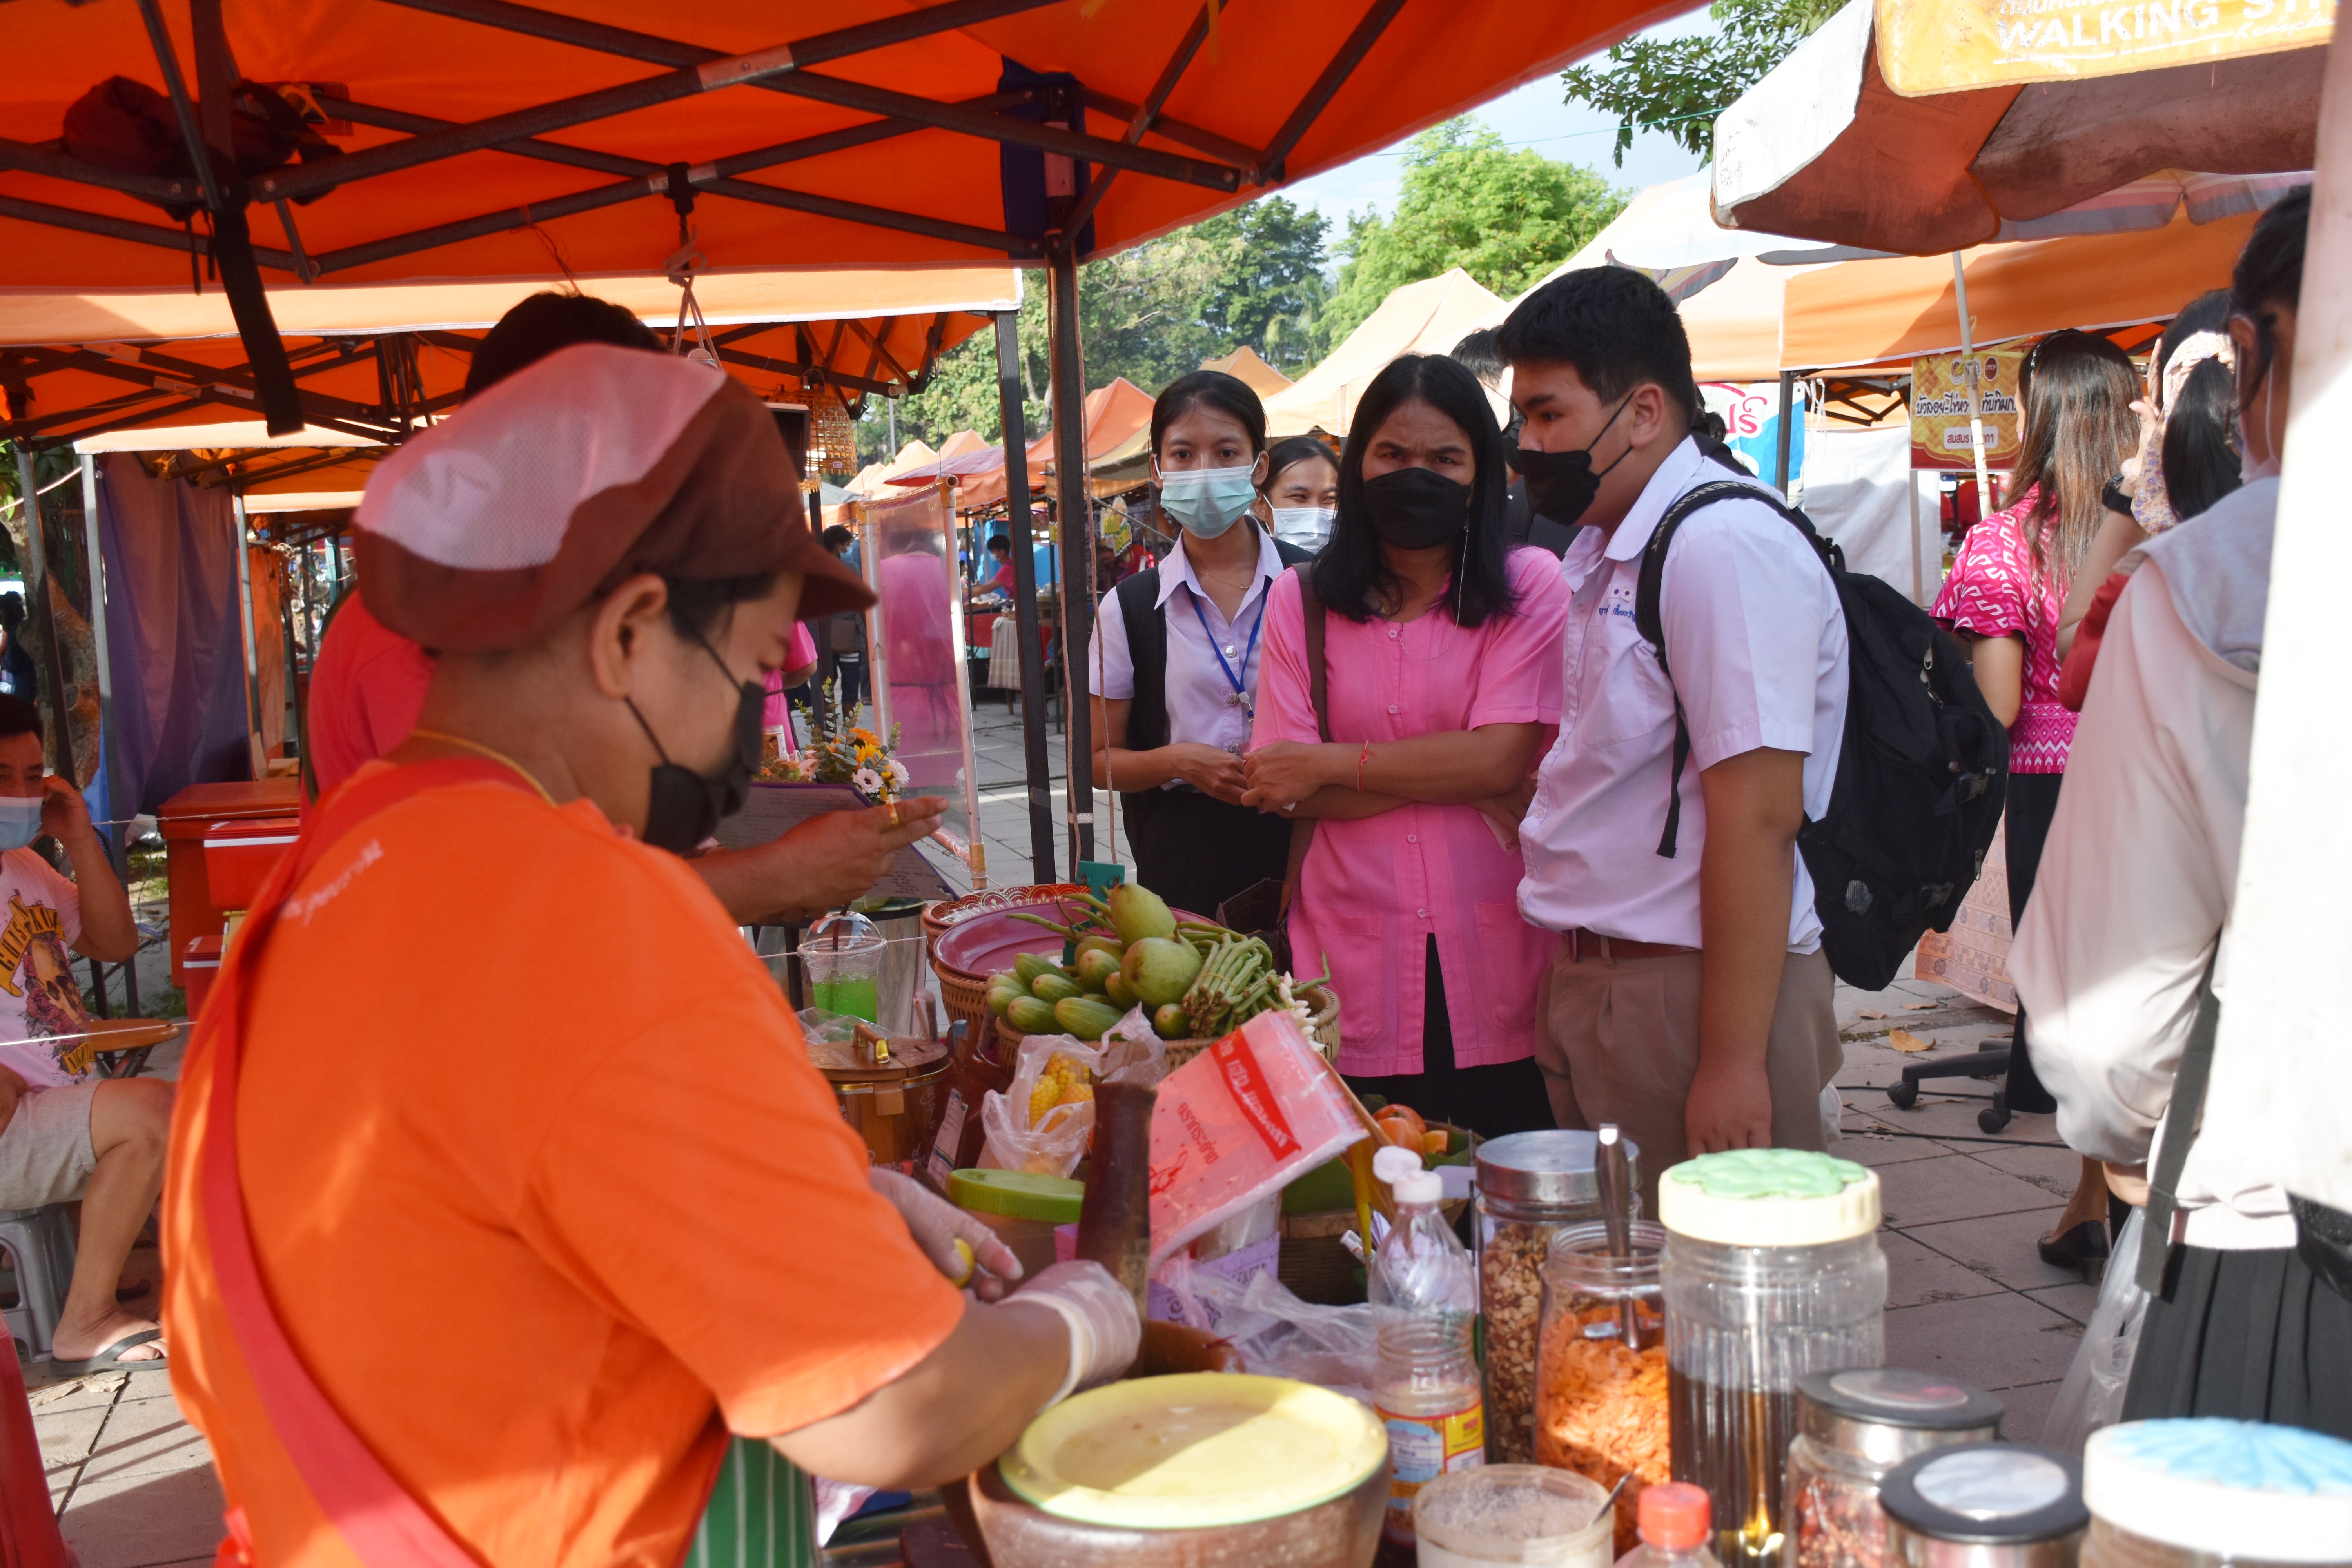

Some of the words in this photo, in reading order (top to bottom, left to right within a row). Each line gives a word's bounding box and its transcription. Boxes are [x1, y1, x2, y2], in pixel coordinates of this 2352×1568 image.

[1997, 0, 2218, 49] WALKING
[1177, 1102, 1219, 1165] ตรากระต่าย
